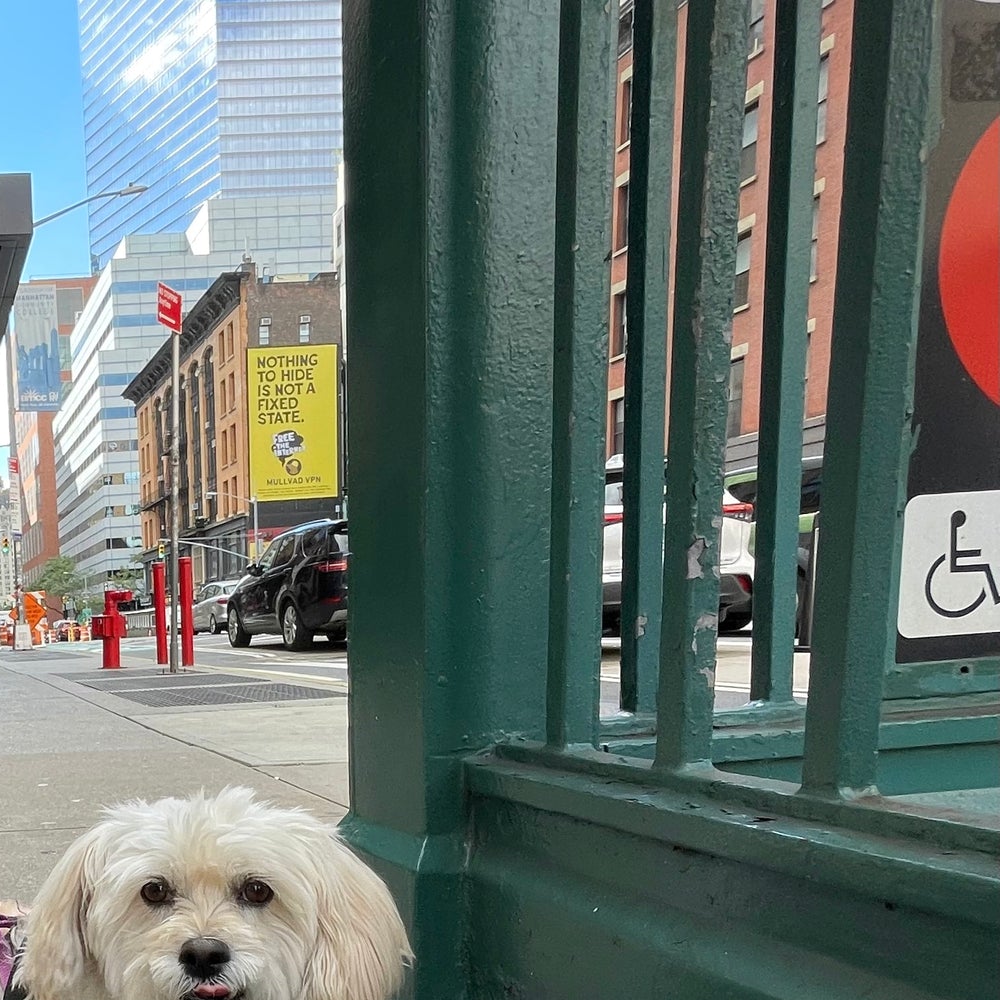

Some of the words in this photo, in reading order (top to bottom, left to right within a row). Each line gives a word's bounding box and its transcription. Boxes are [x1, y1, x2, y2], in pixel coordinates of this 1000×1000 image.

[257, 354, 318, 368] NOTHING
[257, 370, 276, 382] TO
[281, 368, 314, 381] HIDE
[258, 384, 271, 397] IS
[275, 383, 303, 396] NOT
[306, 382, 316, 394] A
[258, 397, 299, 411] FIXED
[258, 411, 304, 425] STATE.
[272, 432, 295, 443] FREE
[266, 477, 304, 486] MULLVAD
